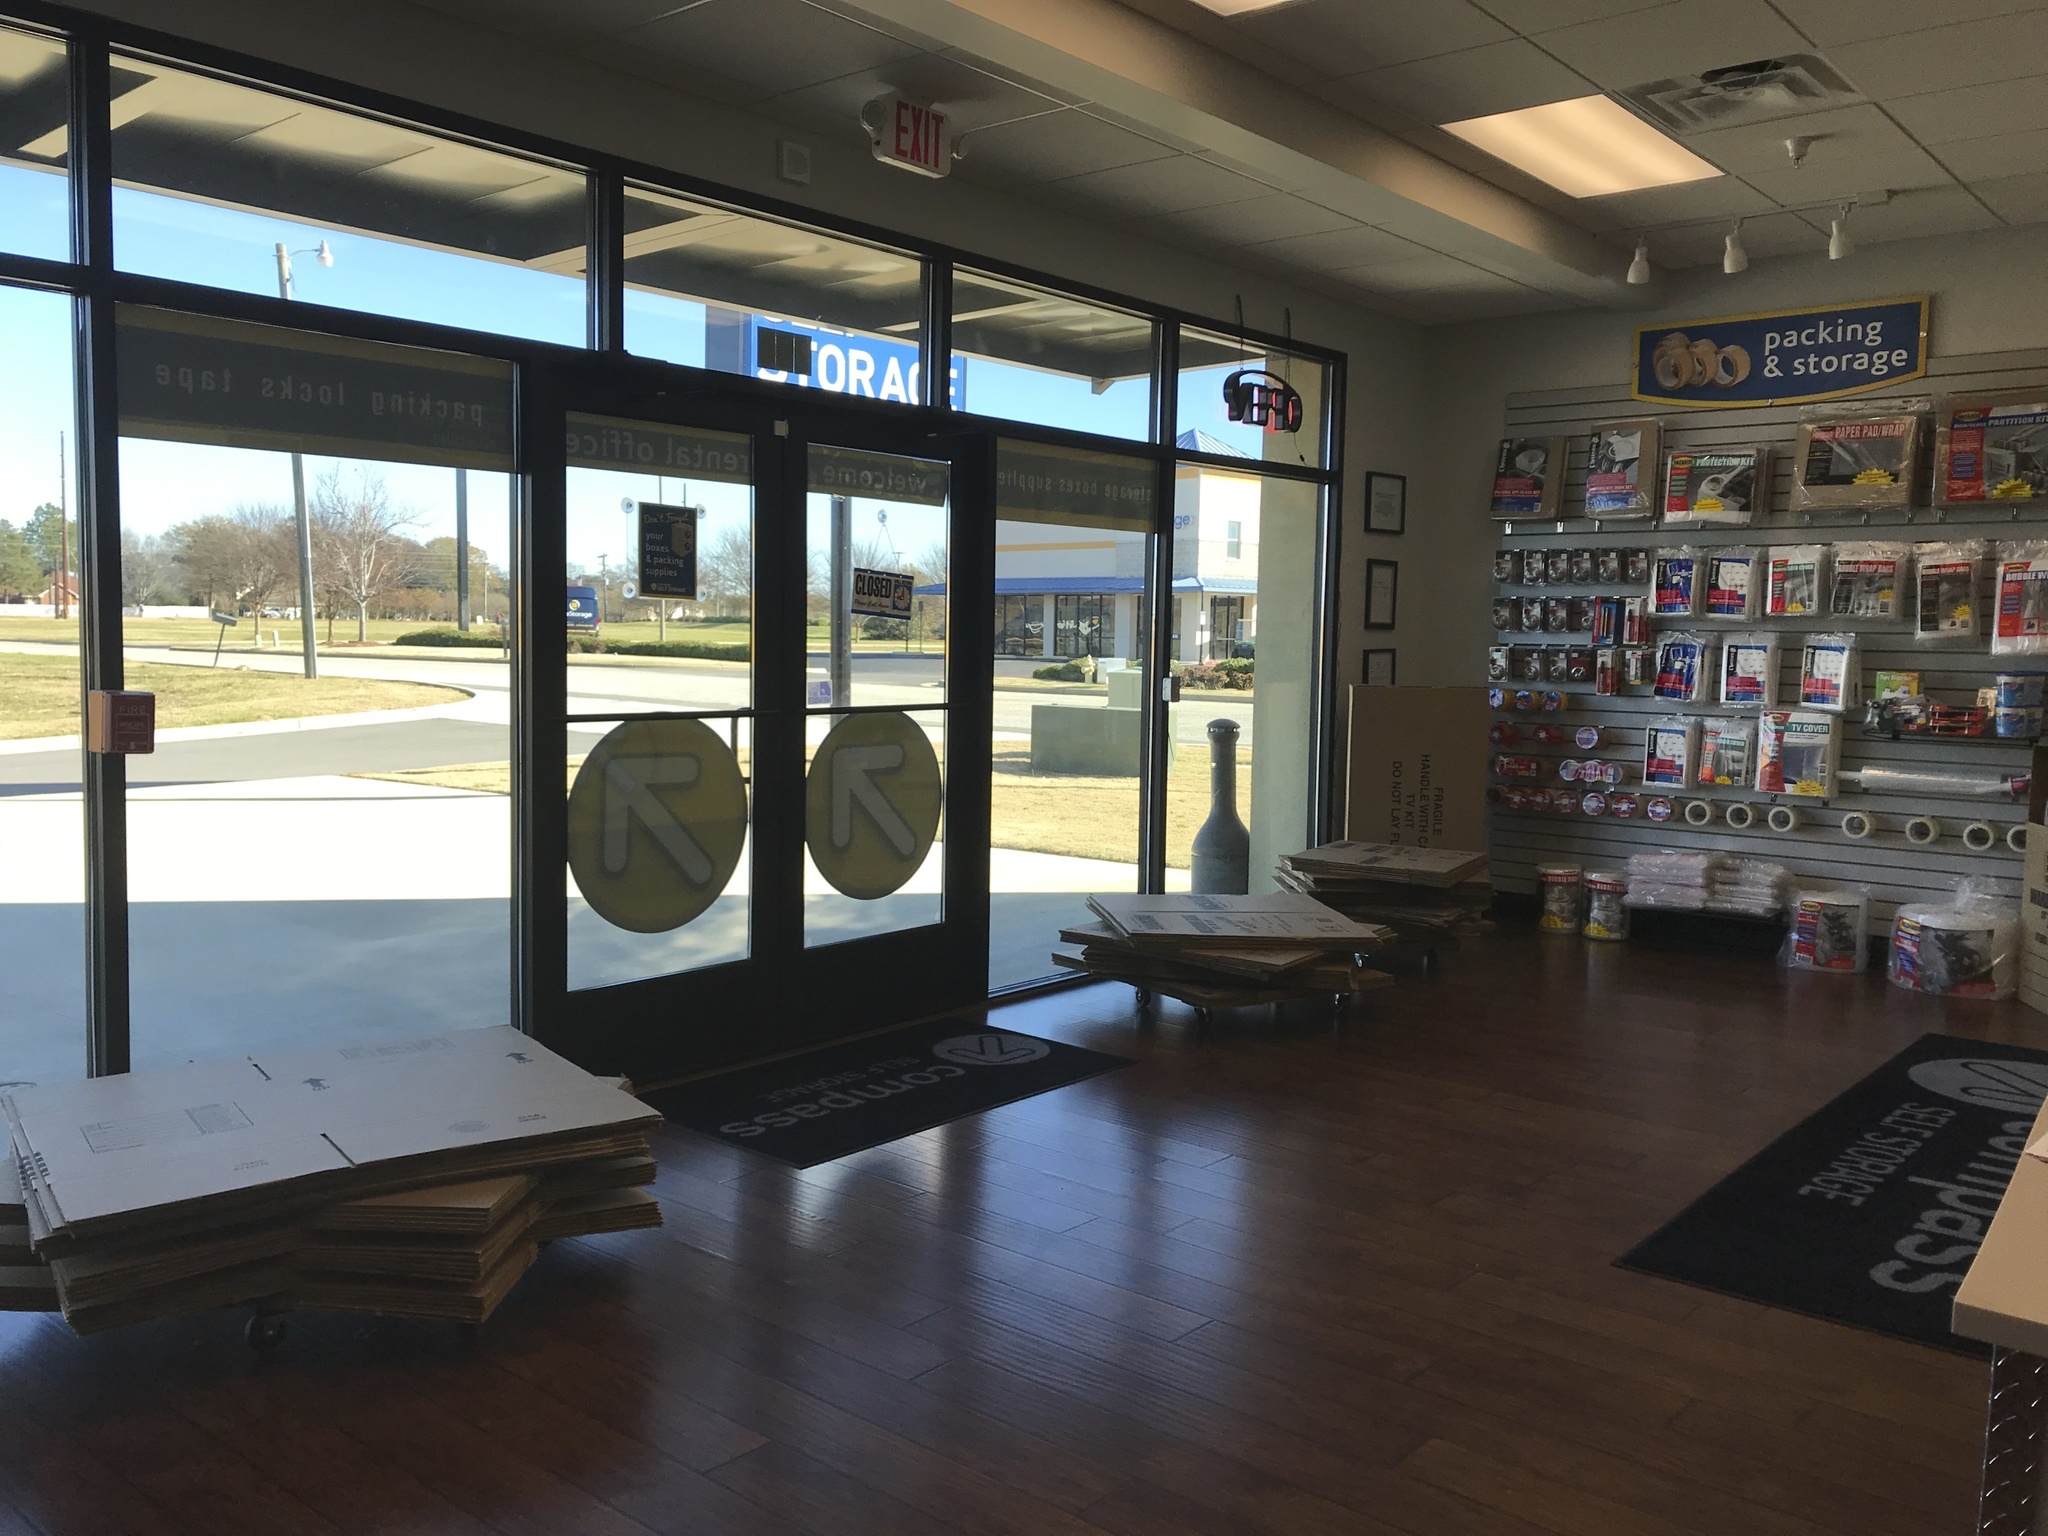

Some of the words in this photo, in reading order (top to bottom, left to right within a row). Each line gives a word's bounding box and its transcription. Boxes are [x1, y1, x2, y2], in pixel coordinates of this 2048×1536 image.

[895, 100, 944, 168] EXIT
[1764, 318, 1884, 355] packing
[1763, 354, 1784, 378] &
[1793, 346, 1909, 376] storage
[1835, 425, 1860, 438] PAPER
[645, 532, 664, 541] your
[645, 543, 669, 553] boxes
[645, 554, 652, 563] &
[653, 557, 685, 568] packing
[645, 568, 678, 578] supplies
[2005, 571, 2037, 581] BUBBLE
[855, 573, 892, 599] CLOSED
[119, 705, 147, 715] FIRE
[1792, 723, 1803, 732] TV
[1803, 724, 1829, 733] COVER
[1392, 761, 1402, 778] DO
[1419, 754, 1431, 802] HANDLE
[1391, 781, 1402, 805] NOT
[1406, 792, 1416, 808] TV
[1390, 808, 1401, 829] LAY
[1405, 811, 1415, 829] KIT
[1418, 804, 1430, 833] WITH
[1432, 787, 1444, 836] FRAGILE
[719, 1065, 966, 1137] compass
[1880, 1101, 1959, 1139] SELF
[1797, 1131, 1923, 1208] STORAGE
